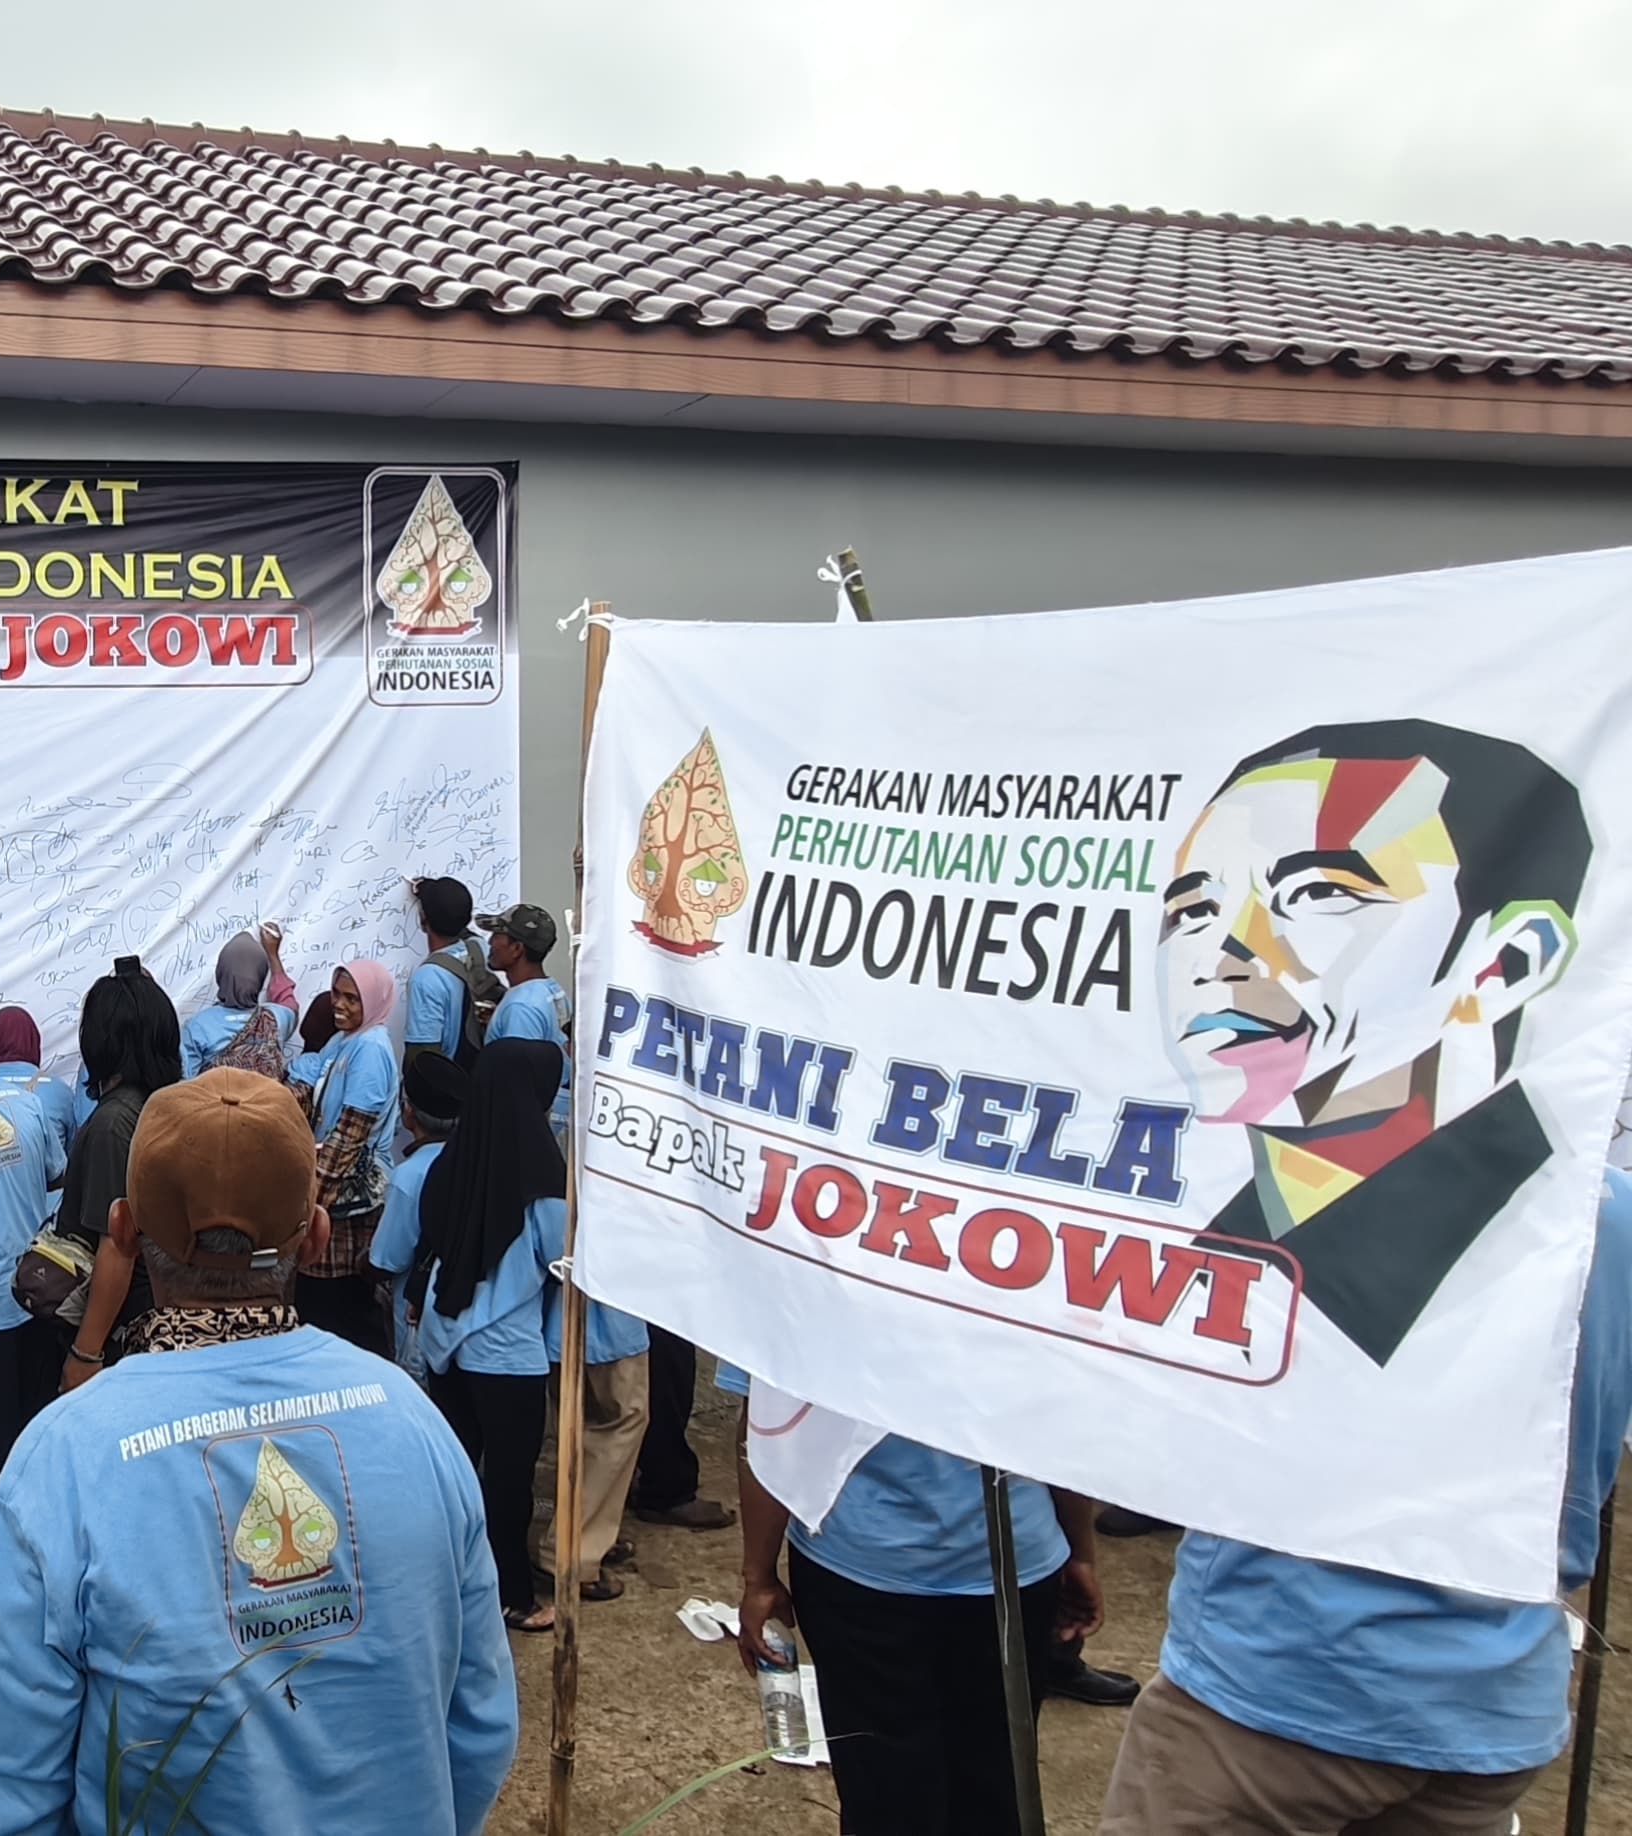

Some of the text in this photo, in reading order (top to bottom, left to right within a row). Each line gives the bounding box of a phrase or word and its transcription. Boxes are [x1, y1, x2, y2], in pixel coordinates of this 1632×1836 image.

[0, 612, 299, 681] JOKOWI
[376, 646, 495, 658] GERAKAN MASYARAKAT
[378, 658, 495, 670] PERHUTANAN SOSIAL
[376, 671, 495, 691] INDONESIA
[785, 764, 1182, 822] GERAKAN MASYARAKAT
[770, 814, 1157, 893] PERHUTANAN SOSIAL
[746, 871, 1133, 1012] INDONESIA
[596, 984, 1195, 1206] PETANI BELA
[588, 1084, 1264, 1348] Bapak JOKOWI
[119, 1383, 388, 1461] PETANI BERGERAK SELAMATKAN JOKOWI
[238, 1596, 285, 1614] GERAKAN
[286, 1583, 353, 1603] MASYARAKAT
[239, 1605, 354, 1644] INDONESIA
